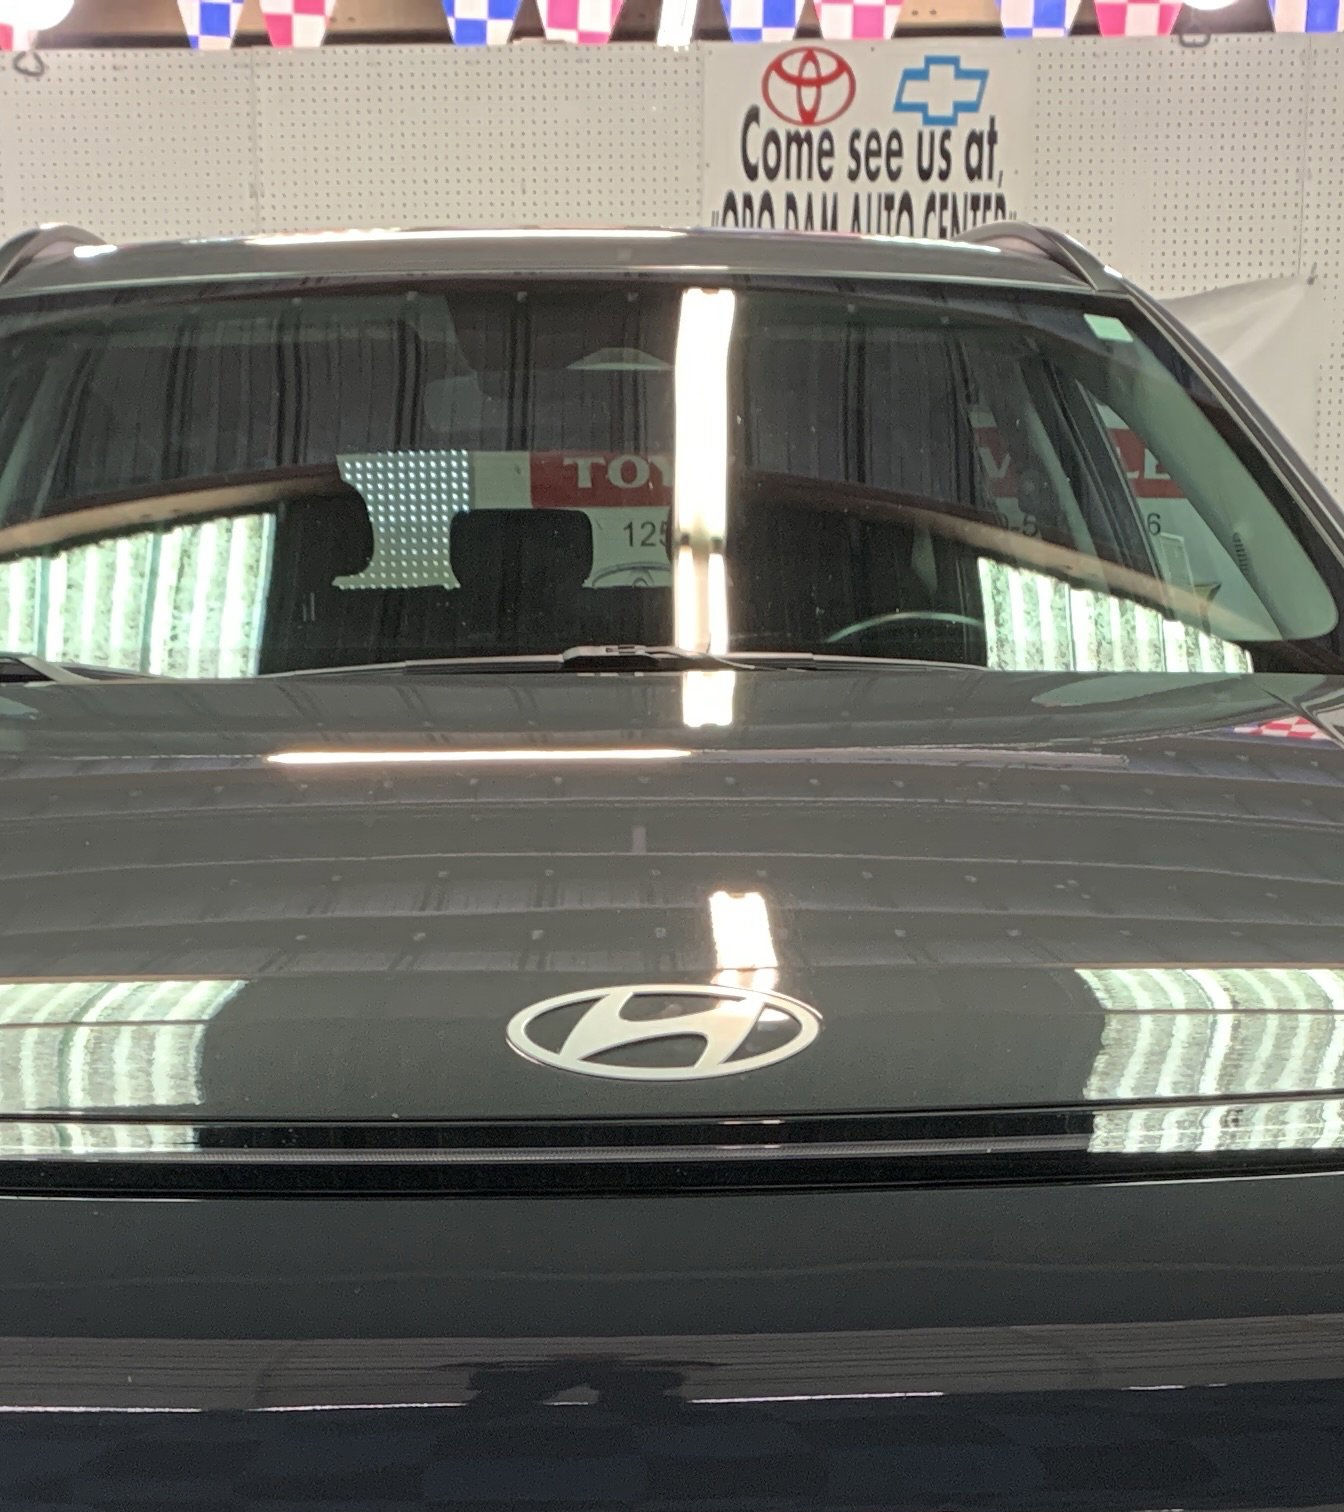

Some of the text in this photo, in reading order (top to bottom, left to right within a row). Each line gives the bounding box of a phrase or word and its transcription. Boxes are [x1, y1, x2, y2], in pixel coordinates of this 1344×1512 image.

[741, 104, 835, 182] Come
[847, 128, 904, 182] see
[917, 128, 953, 182] us
